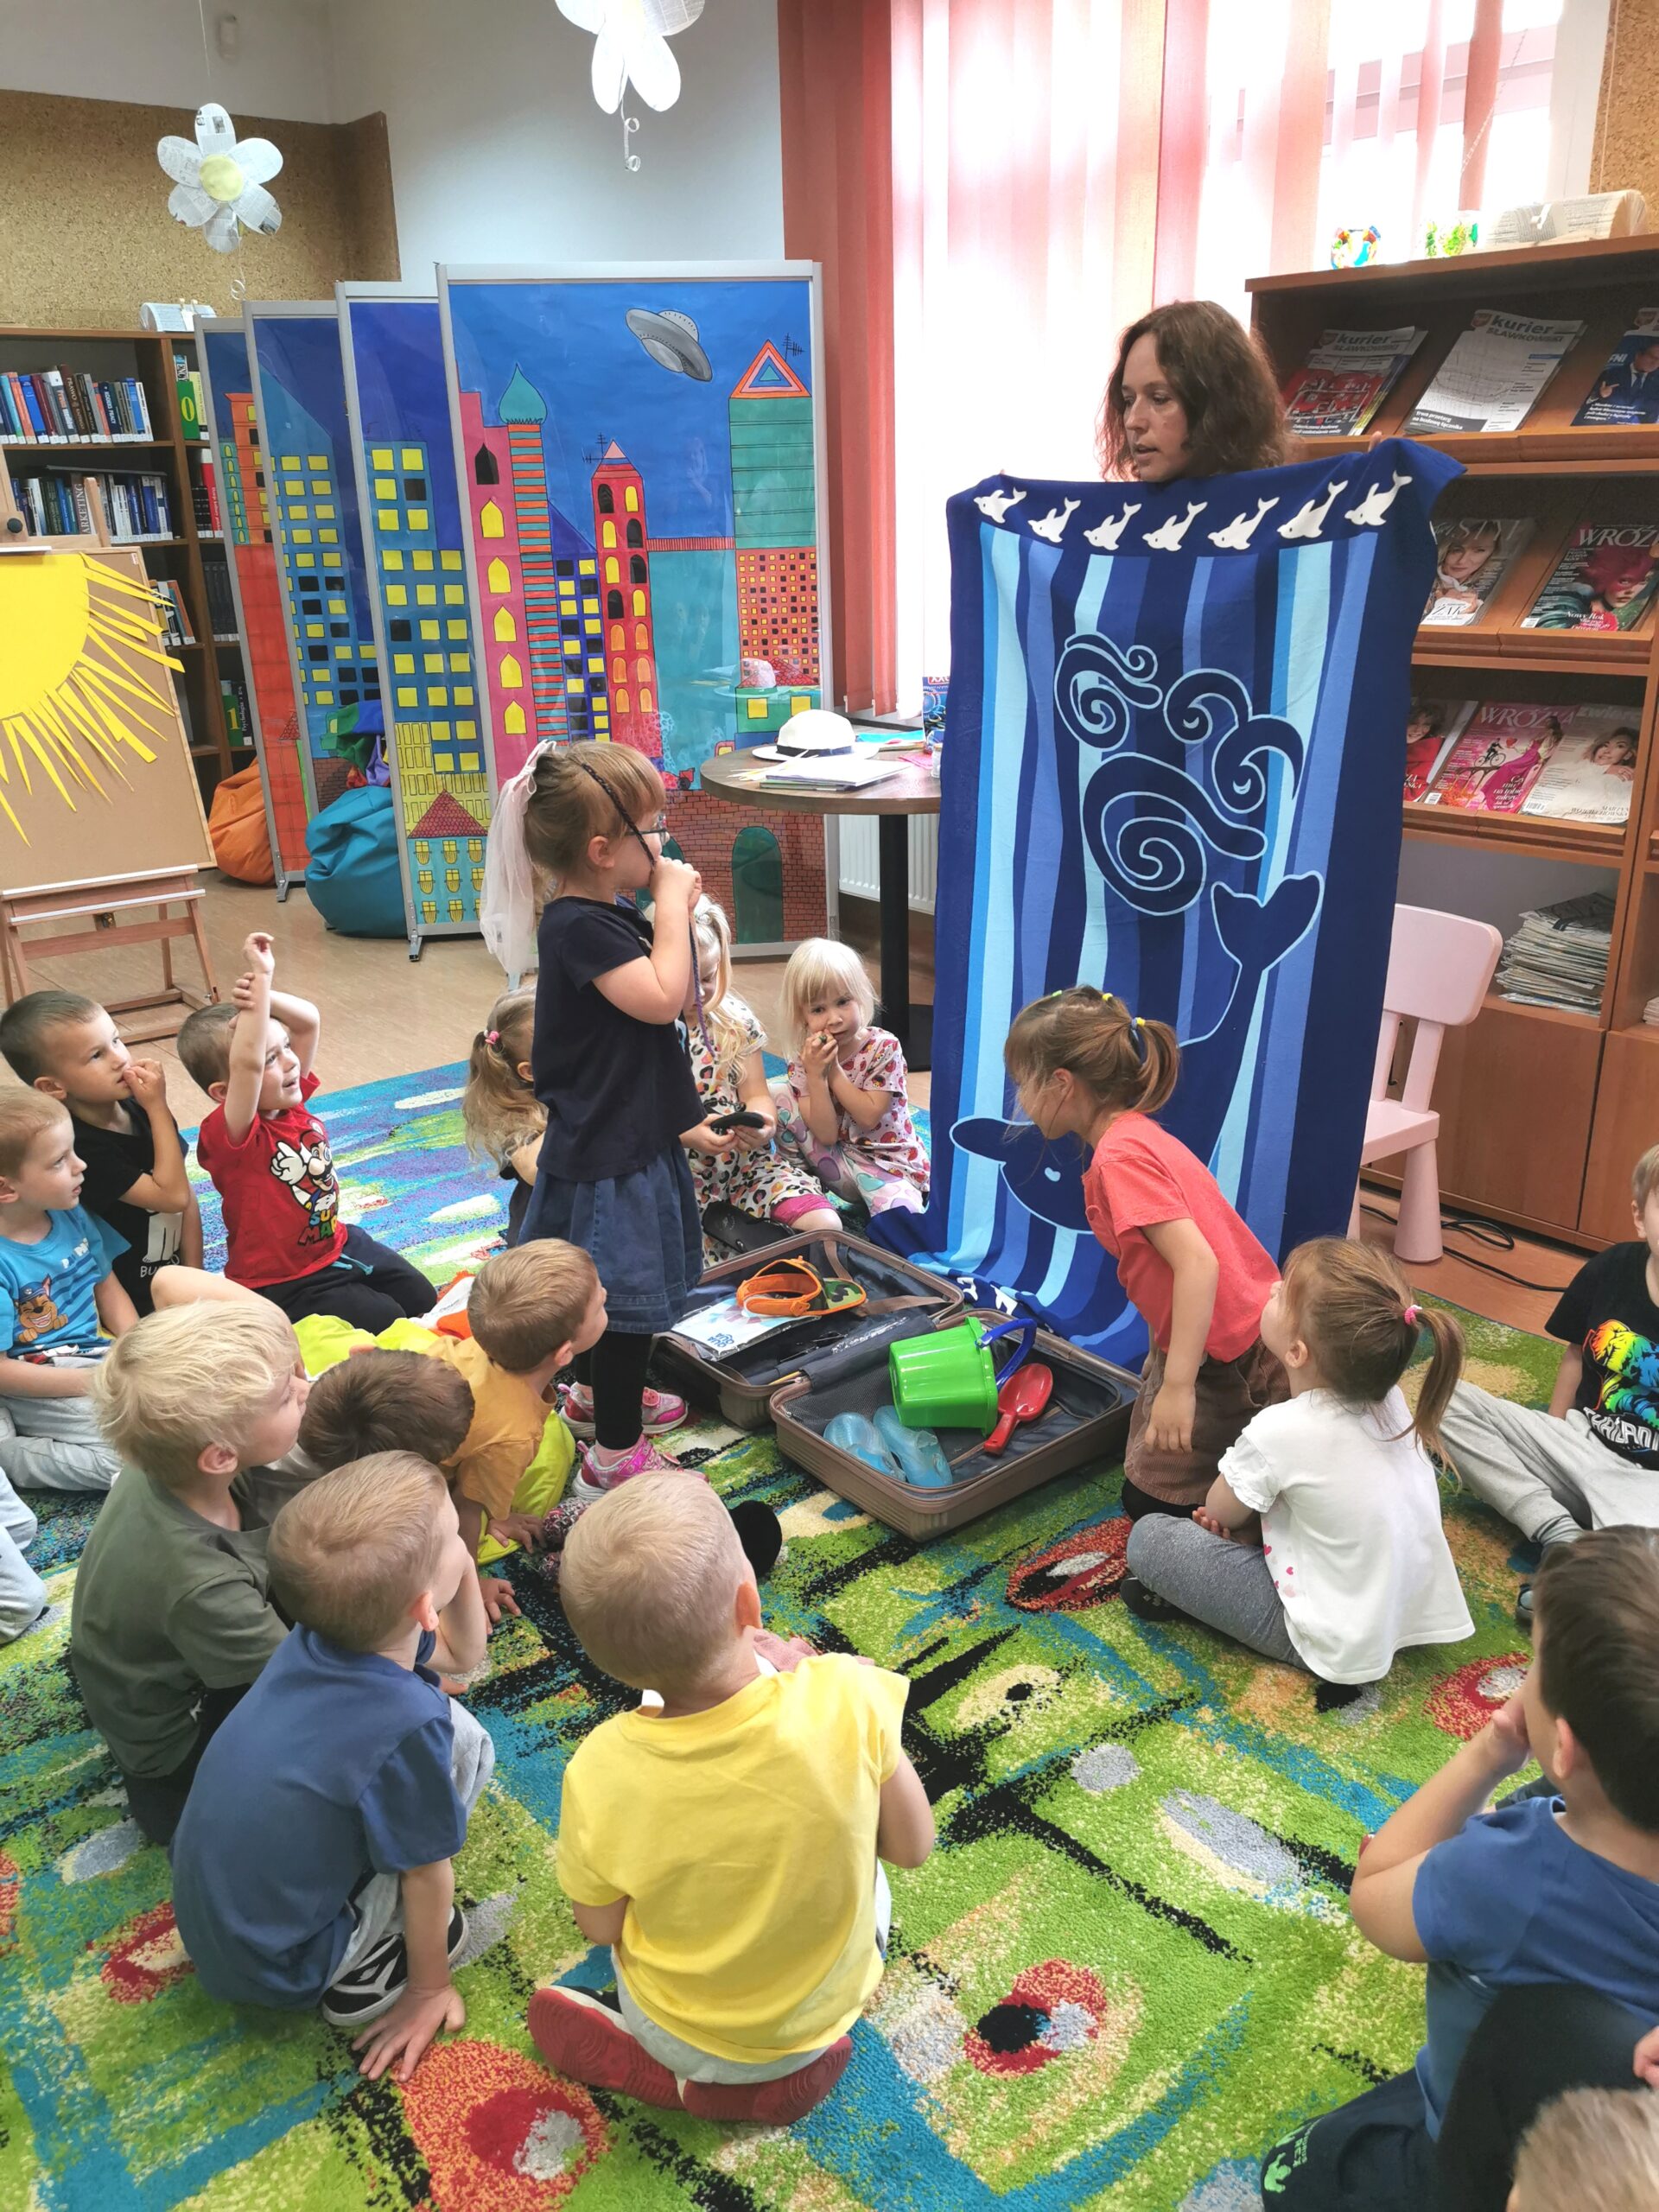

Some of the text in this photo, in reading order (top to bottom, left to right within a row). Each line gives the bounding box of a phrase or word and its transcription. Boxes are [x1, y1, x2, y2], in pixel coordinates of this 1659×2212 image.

[1492, 315, 1554, 334] kurier
[1338, 334, 1391, 345] kurier
[75, 484, 91, 534] ARKETING
